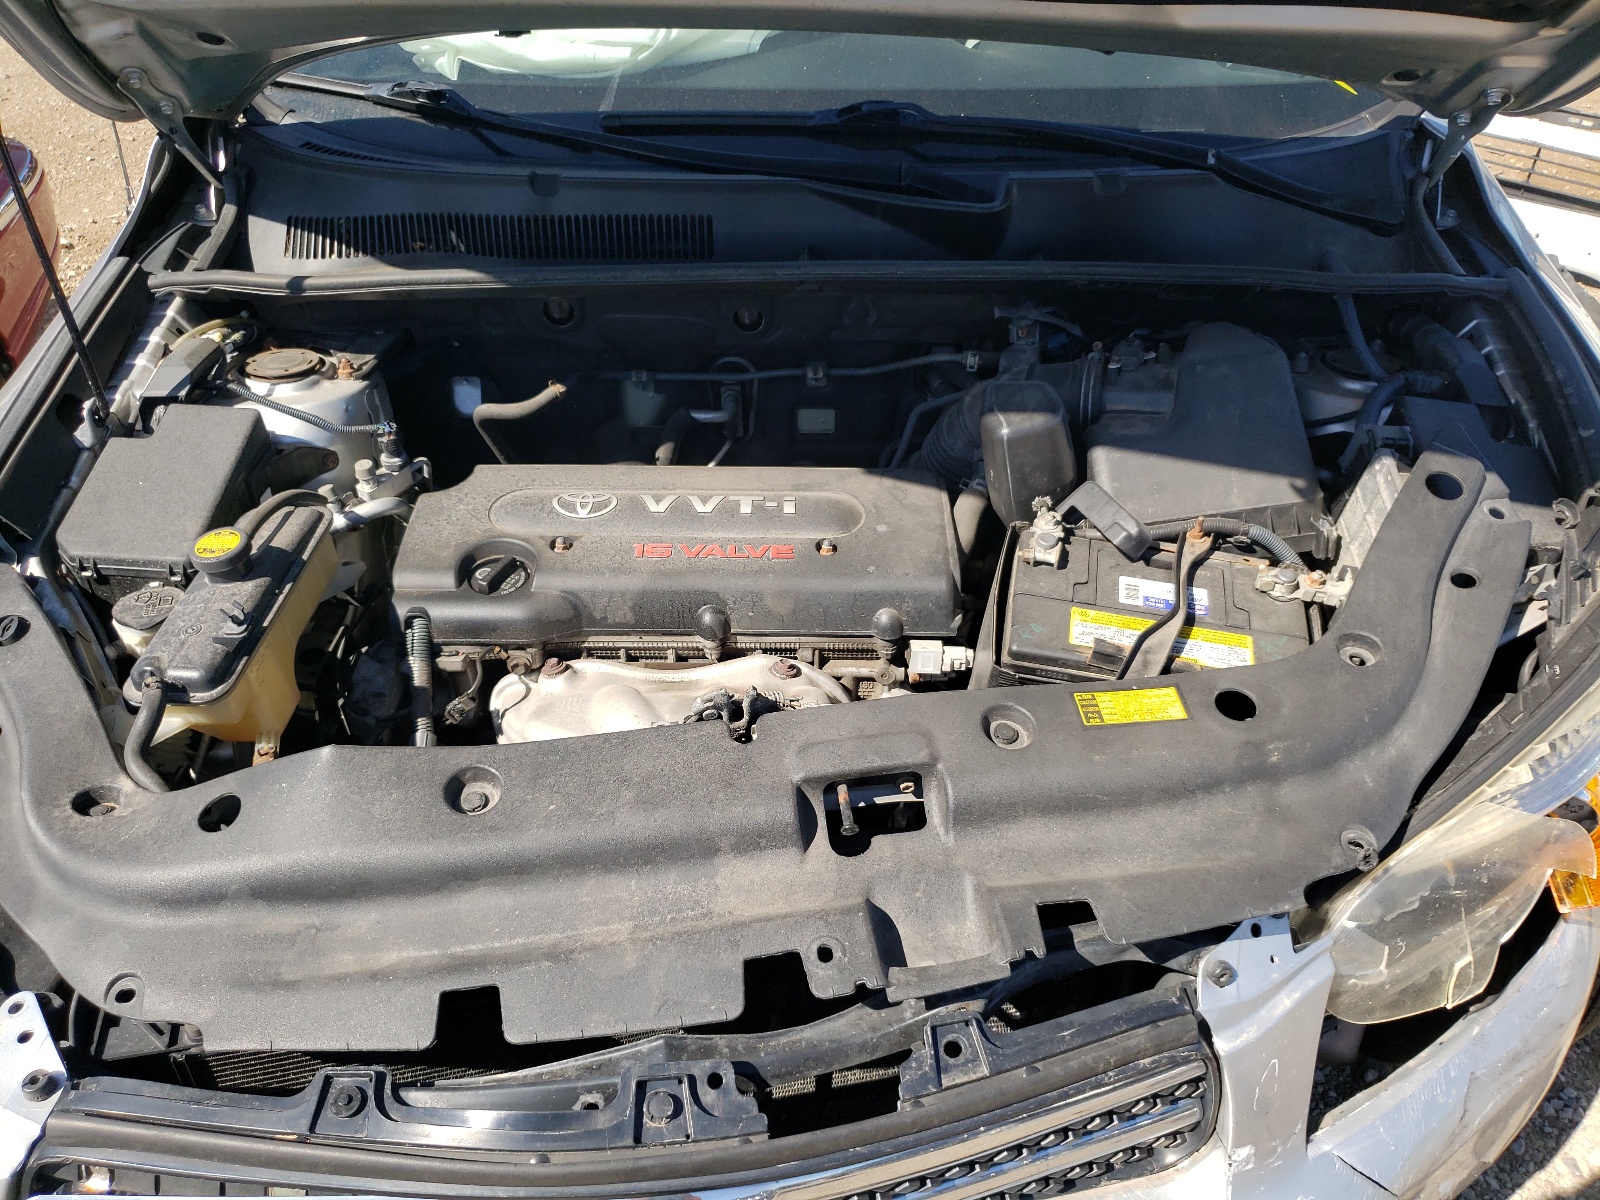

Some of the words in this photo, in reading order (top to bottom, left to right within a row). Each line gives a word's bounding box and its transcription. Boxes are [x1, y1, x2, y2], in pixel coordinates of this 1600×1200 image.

[639, 494, 796, 514] VVT-i
[633, 543, 673, 558] 16
[678, 543, 795, 559] VALVE
